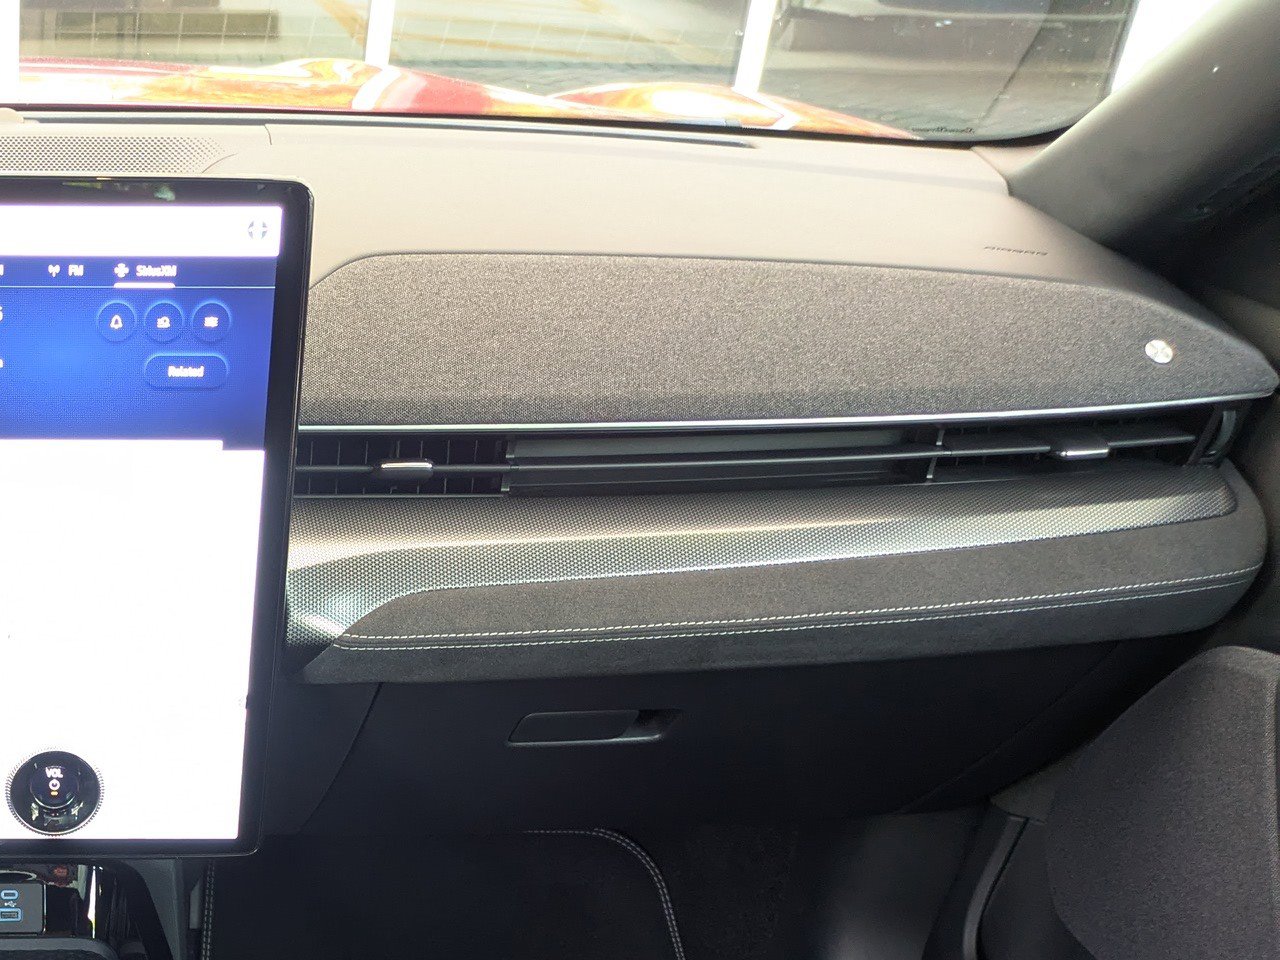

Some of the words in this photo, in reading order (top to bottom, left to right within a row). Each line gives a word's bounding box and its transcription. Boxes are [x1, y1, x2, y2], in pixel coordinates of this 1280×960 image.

[68, 264, 84, 276] FM
[136, 264, 177, 277] SiriusXM
[168, 365, 204, 378] Related
[45, 766, 64, 778] VOL
